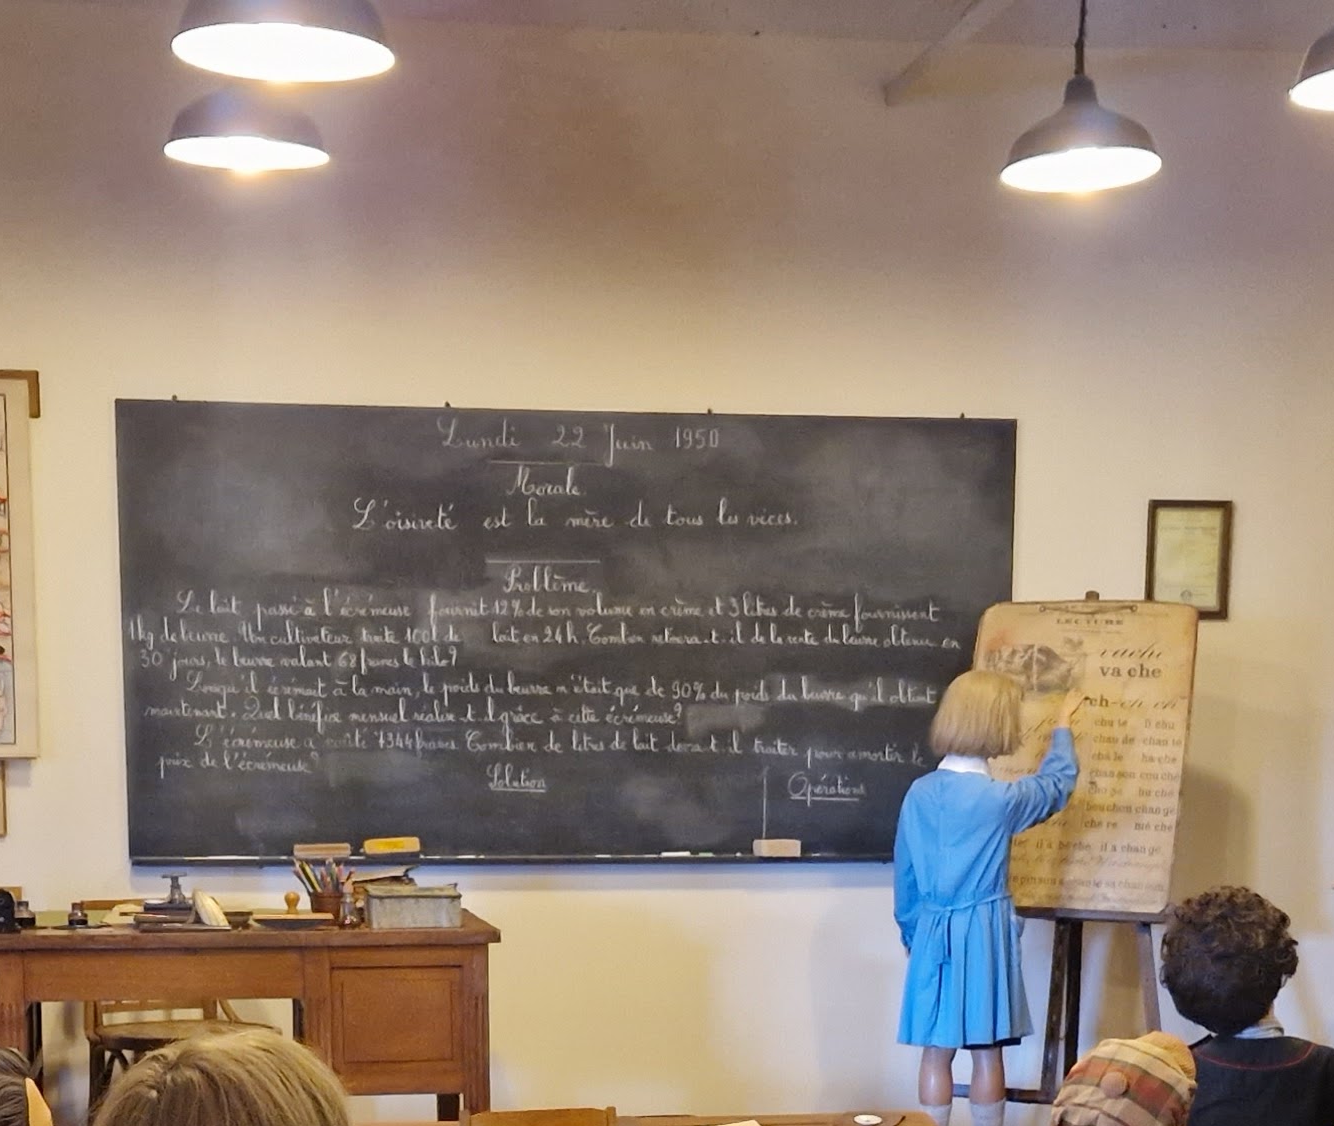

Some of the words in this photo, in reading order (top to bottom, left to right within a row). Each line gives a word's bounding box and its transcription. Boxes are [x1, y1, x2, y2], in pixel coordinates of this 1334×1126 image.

[437, 416, 521, 448] Lundi
[551, 424, 587, 448] 22
[603, 423, 655, 468] Juin
[675, 426, 719, 448] 1950
[352, 498, 457, 530] L'oisiveté
[483, 507, 512, 529] est
[527, 497, 547, 527] la
[565, 508, 614, 528] mère
[629, 500, 651, 528] de
[666, 504, 703, 526] tous
[717, 497, 738, 526] les
[747, 508, 798, 527] vices.
[176, 590, 203, 614] Le
[210, 589, 241, 615] lait
[427, 593, 490, 628] fournit
[576, 592, 633, 616] volume
[639, 606, 655, 617] en
[661, 594, 704, 617] crème
[708, 597, 726, 616] et
[729, 598, 740, 618] 3
[742, 591, 778, 617] litres
[782, 596, 802, 618] de
[807, 601, 851, 619] crème
[160, 616, 178, 643] de
[360, 624, 400, 644] traite
[443, 624, 461, 643] de
[492, 621, 519, 643] lait
[523, 632, 539, 644] en
[751, 622, 767, 644] de
[770, 622, 784, 644] la
[823, 624, 841, 644] du
[841, 623, 879, 646] beurre
[941, 637, 961, 649] en
[140, 650, 163, 668] 30
[214, 646, 227, 667] le
[232, 645, 275, 667] beurre
[280, 645, 332, 667] valant
[338, 652, 356, 668] 68
[403, 647, 416, 667] le
[333, 680, 347, 697] à
[352, 674, 367, 697] la
[423, 672, 435, 695] le
[440, 672, 480, 707] poids
[484, 674, 504, 694] du
[507, 671, 552, 695] beurre
[616, 684, 640, 706] que
[646, 676, 666, 698] de
[710, 681, 730, 700] du
[777, 678, 798, 702] du
[801, 675, 846, 701] beurre
[242, 696, 280, 721] Quel
[349, 697, 408, 723] mensuel
[550, 707, 563, 722] à
[569, 703, 600, 724] cette
[465, 727, 536, 752] Combien
[543, 730, 564, 754] de
[572, 728, 604, 751] litres
[610, 730, 627, 751] de
[633, 727, 659, 752] lait
[754, 737, 799, 757] traiter
[806, 747, 843, 769] pour
[847, 743, 905, 764] amortir
[157, 753, 193, 779] prix
[200, 752, 217, 769] de
[486, 762, 546, 789] Solution
